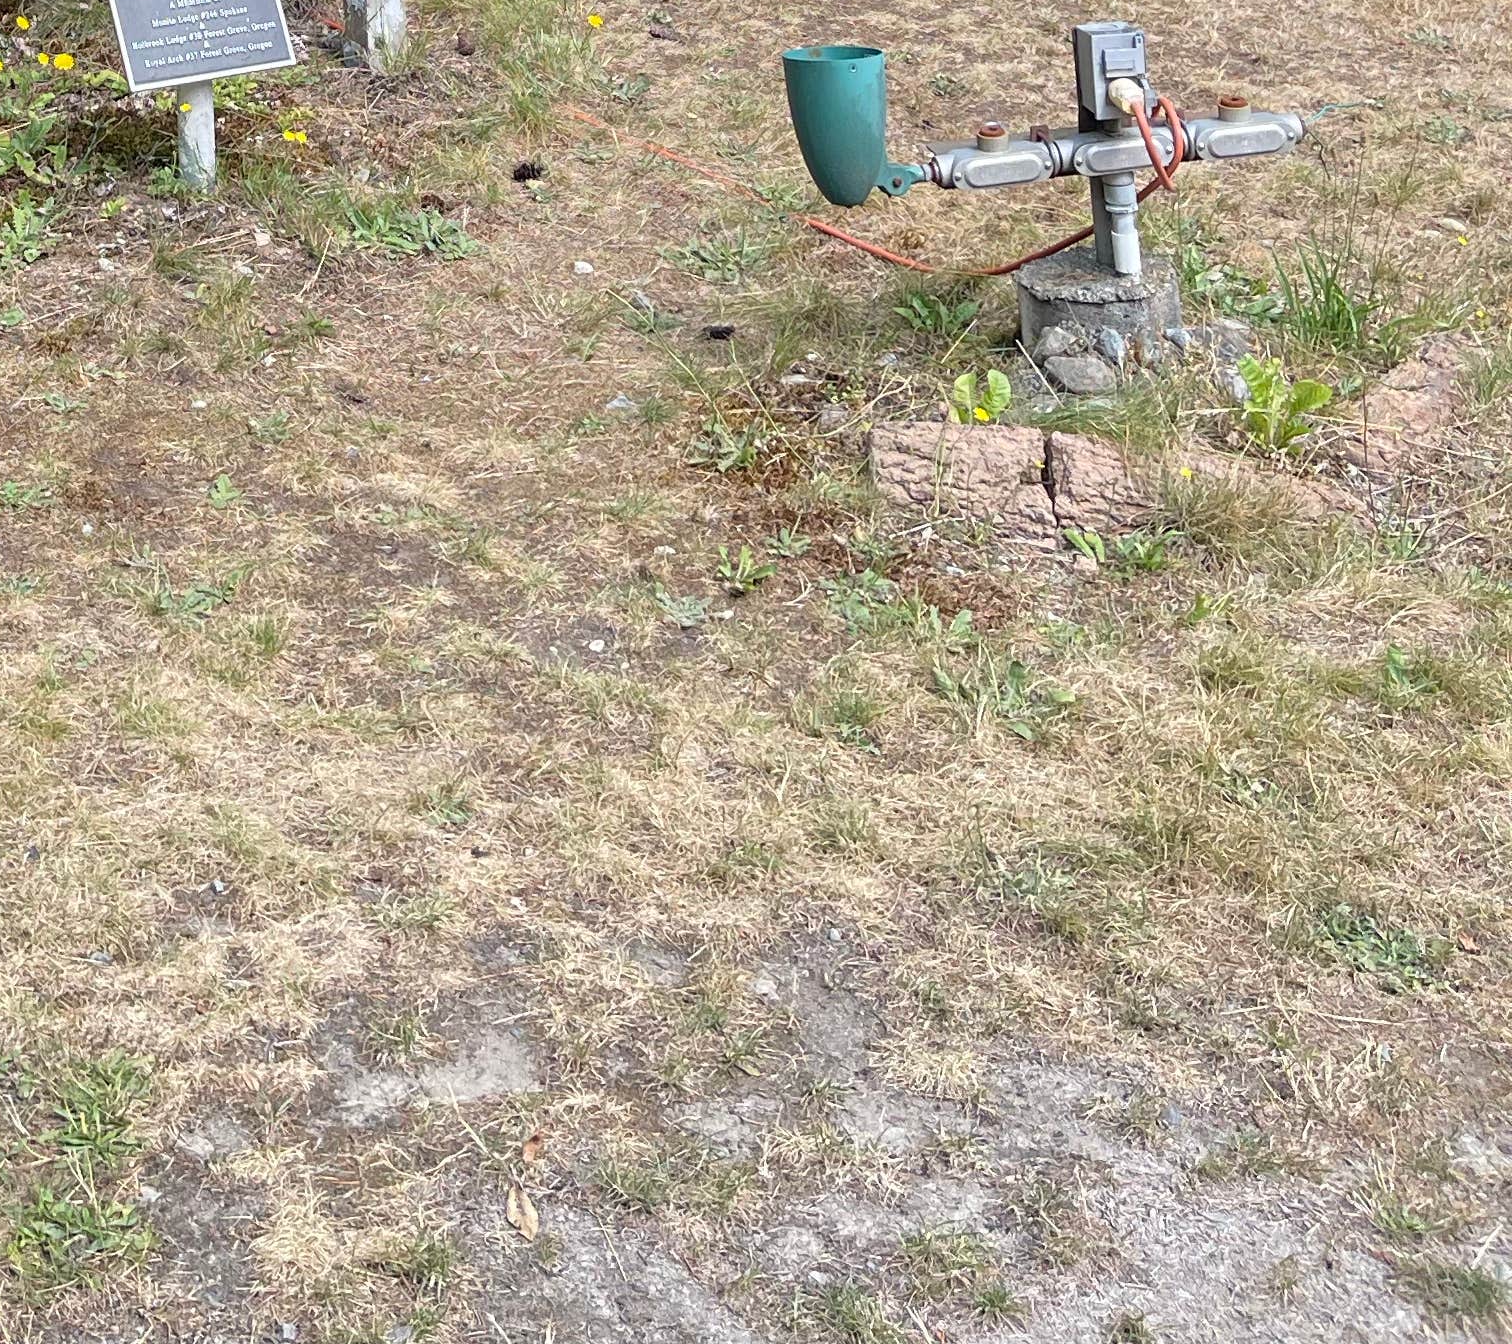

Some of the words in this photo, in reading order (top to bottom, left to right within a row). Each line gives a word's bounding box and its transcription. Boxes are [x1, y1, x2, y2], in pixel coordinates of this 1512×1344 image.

[169, 0, 175, 9] A
[178, 11, 199, 24] Lodge
[219, 6, 247, 18] Spokane
[166, 35, 187, 46] Lodge
[204, 29, 225, 40] Forest
[251, 21, 276, 32] Oregon
[145, 56, 165, 69] Royal
[167, 54, 184, 64] Arch
[201, 48, 222, 59] Forest
[248, 40, 273, 52] Oregon
